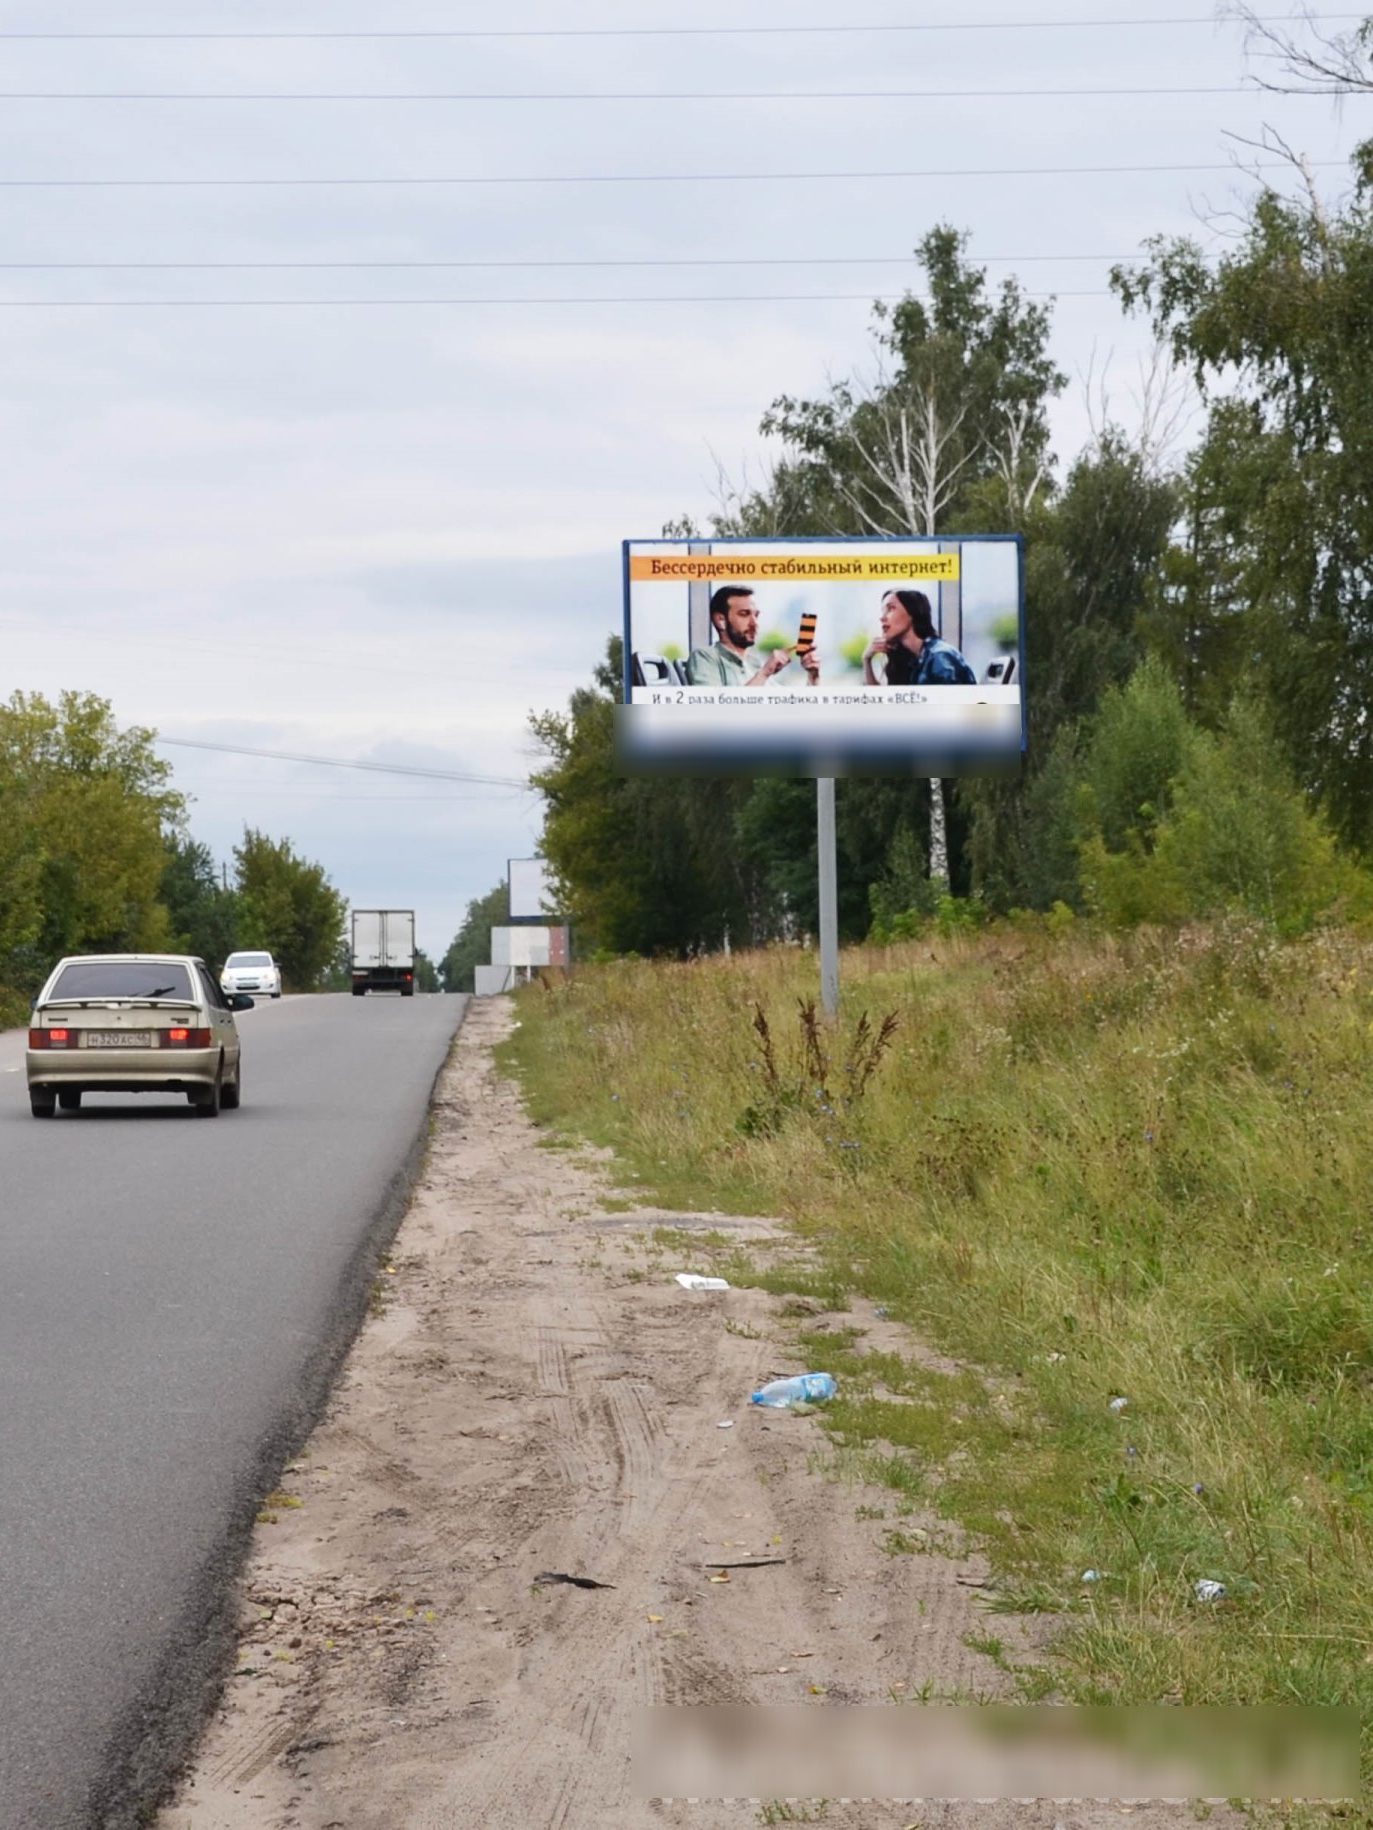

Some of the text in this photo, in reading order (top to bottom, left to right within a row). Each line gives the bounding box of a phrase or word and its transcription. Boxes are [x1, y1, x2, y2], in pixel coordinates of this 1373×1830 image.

[651, 558, 953, 578] Бессердечно стабильный интернет!
[652, 694, 661, 704] И
[665, 695, 672, 704] в
[676, 691, 684, 704] 2
[688, 695, 715, 704] раза
[718, 692, 764, 704] больше
[767, 693, 819, 704] трафика
[822, 695, 830, 704] в
[832, 693, 884, 704] тарифах
